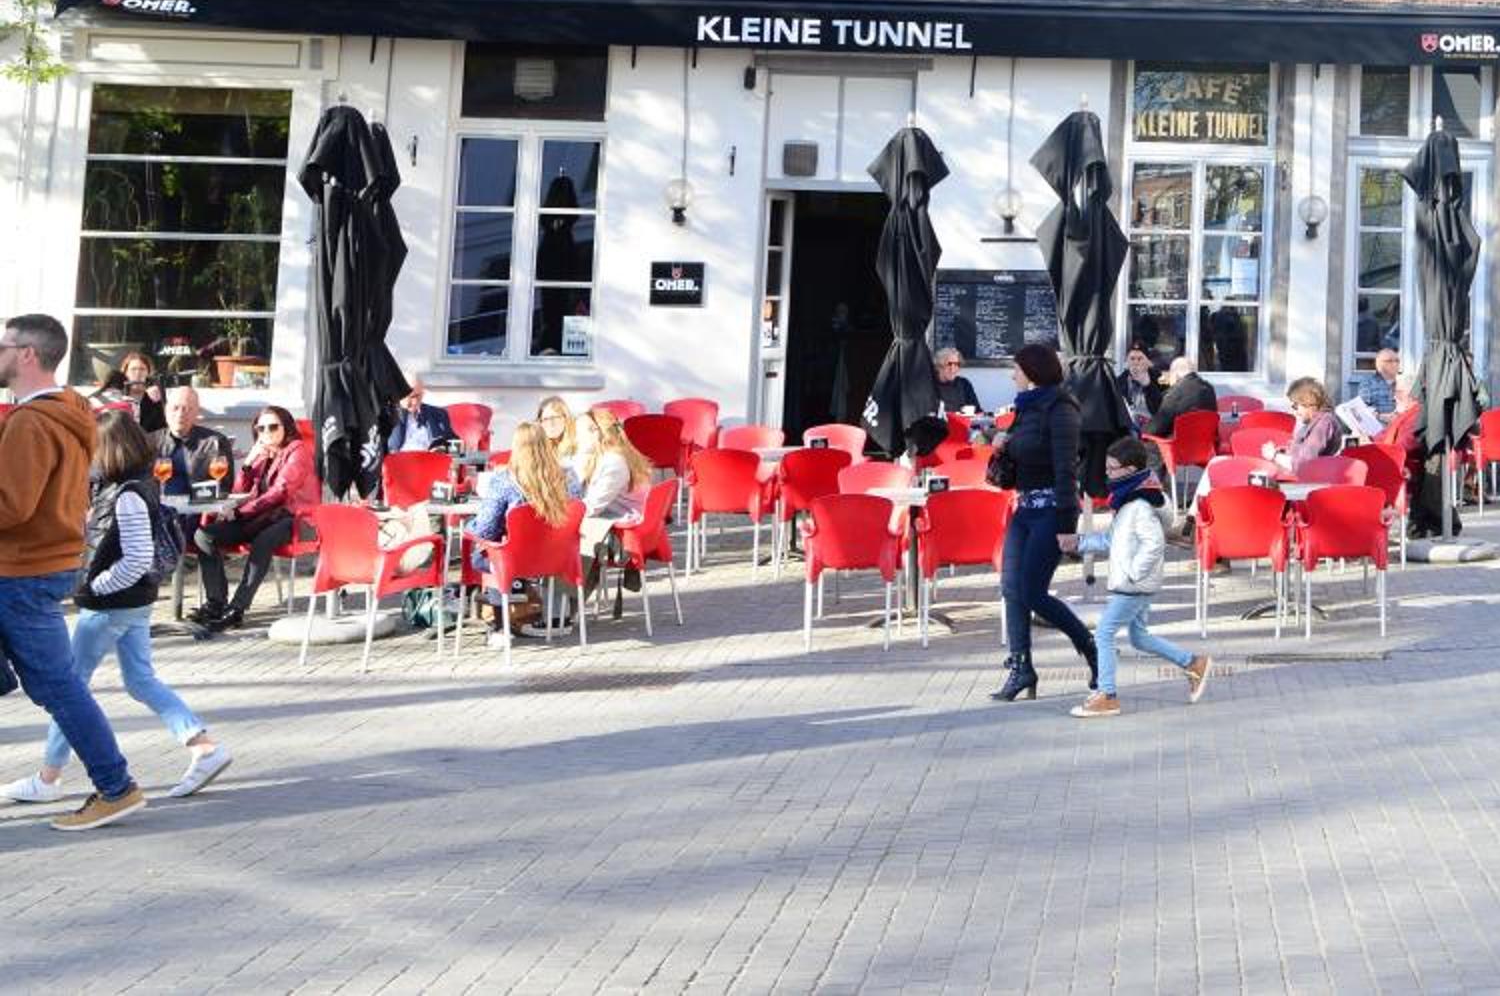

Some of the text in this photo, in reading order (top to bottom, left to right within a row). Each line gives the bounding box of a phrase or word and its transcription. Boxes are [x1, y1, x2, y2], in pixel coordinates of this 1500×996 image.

[697, 15, 973, 50] KLEINE TUNNEL
[1135, 109, 1265, 139] KLEINE TUNNEL
